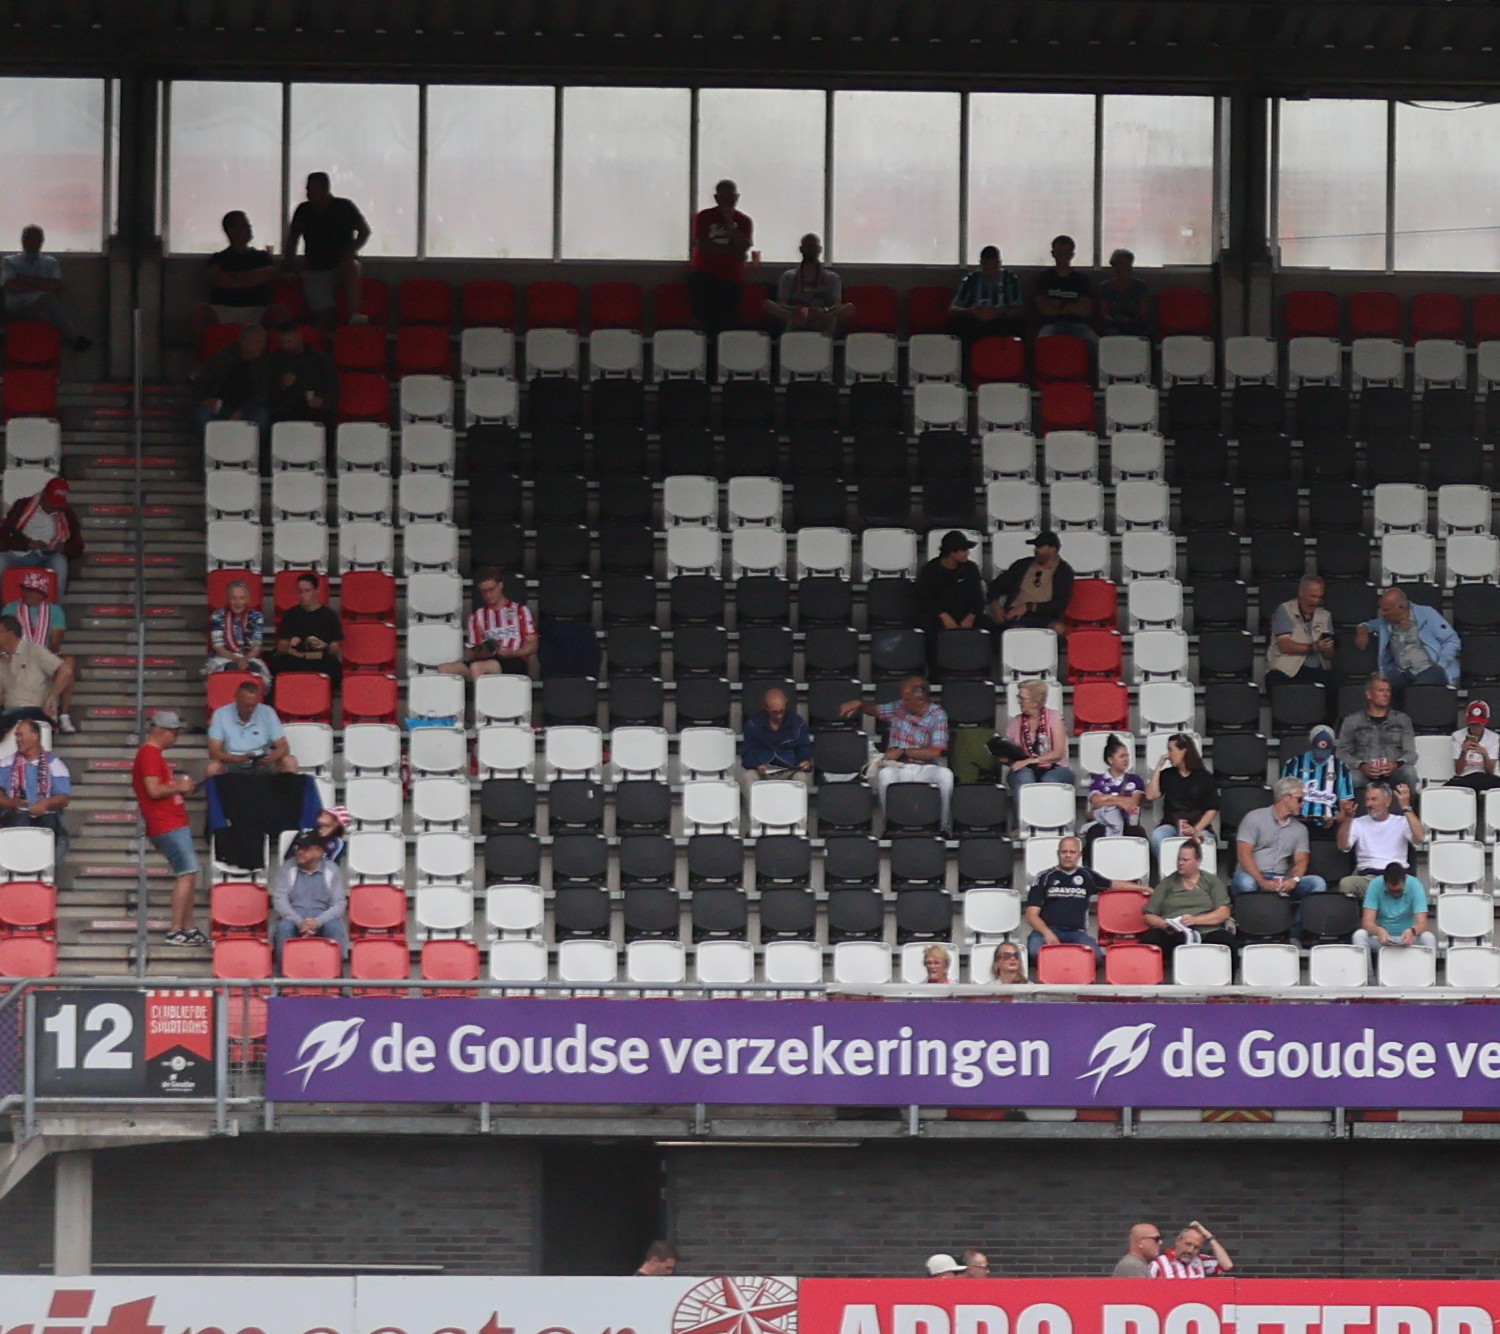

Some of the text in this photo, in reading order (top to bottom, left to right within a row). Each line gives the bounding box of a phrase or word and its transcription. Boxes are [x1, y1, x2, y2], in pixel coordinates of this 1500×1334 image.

[44, 1002, 133, 1069] 12
[370, 1021, 1050, 1088] de Goudse verzekeringen
[1162, 1027, 1226, 1078] de
[1238, 1027, 1437, 1079] Goudse
